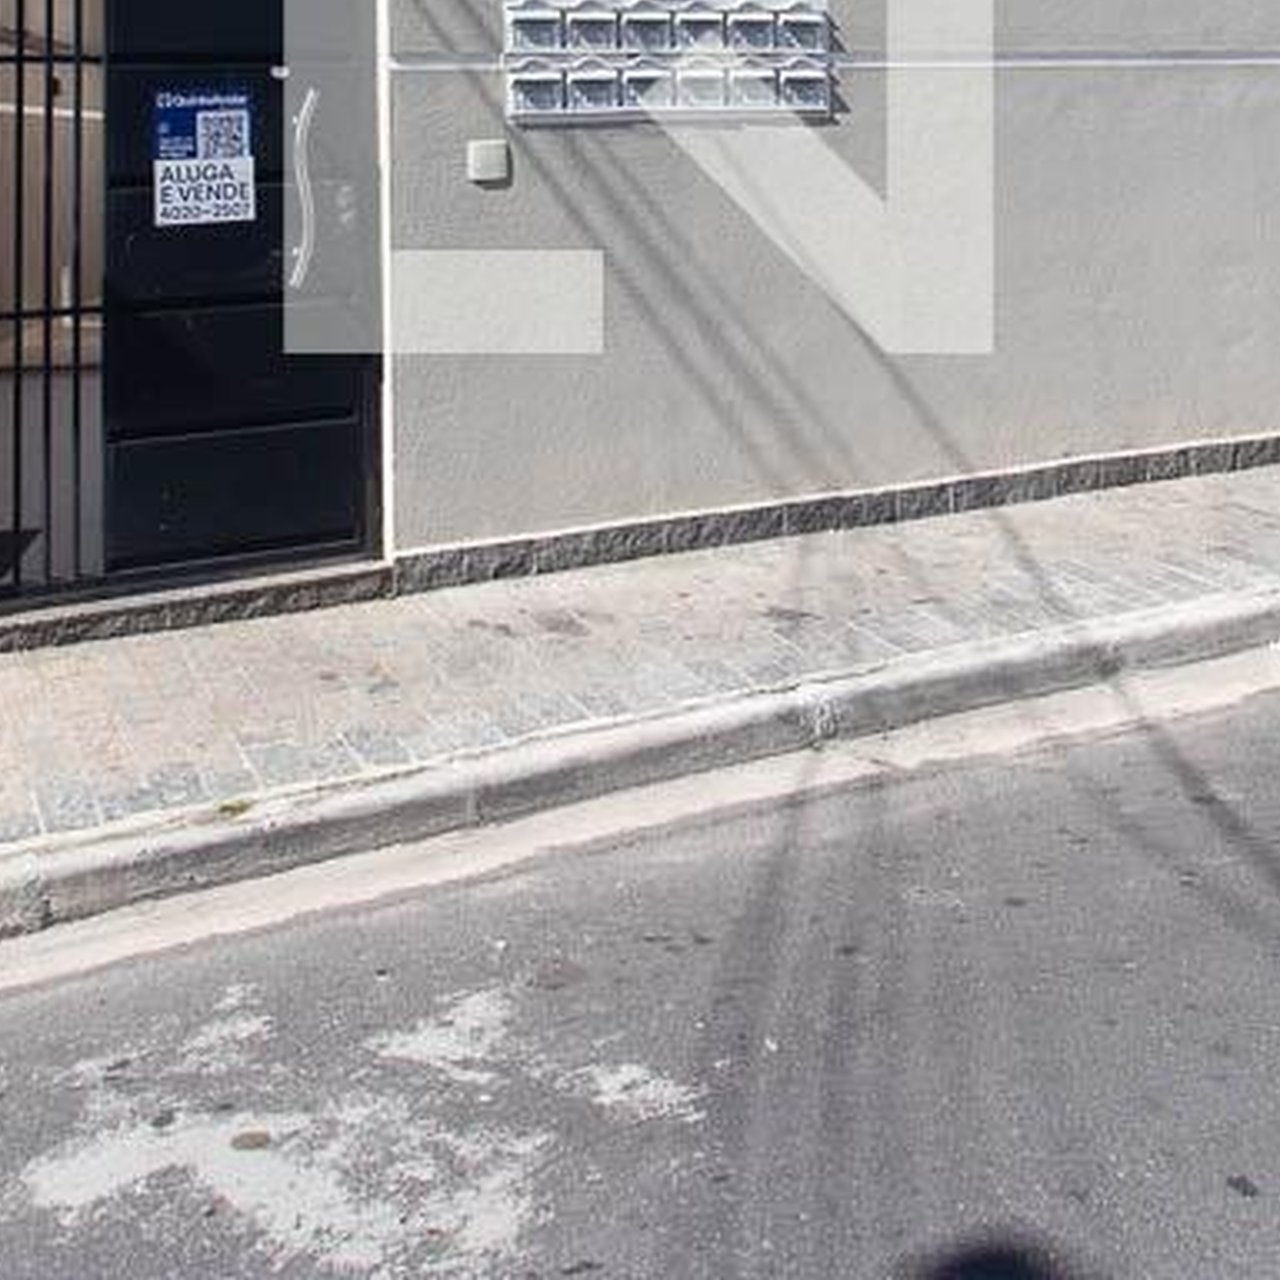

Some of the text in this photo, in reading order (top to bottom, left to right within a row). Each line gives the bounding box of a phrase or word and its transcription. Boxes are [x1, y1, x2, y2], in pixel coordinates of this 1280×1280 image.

[160, 163, 235, 184] ALUGA
[160, 183, 250, 204] E VENDE
